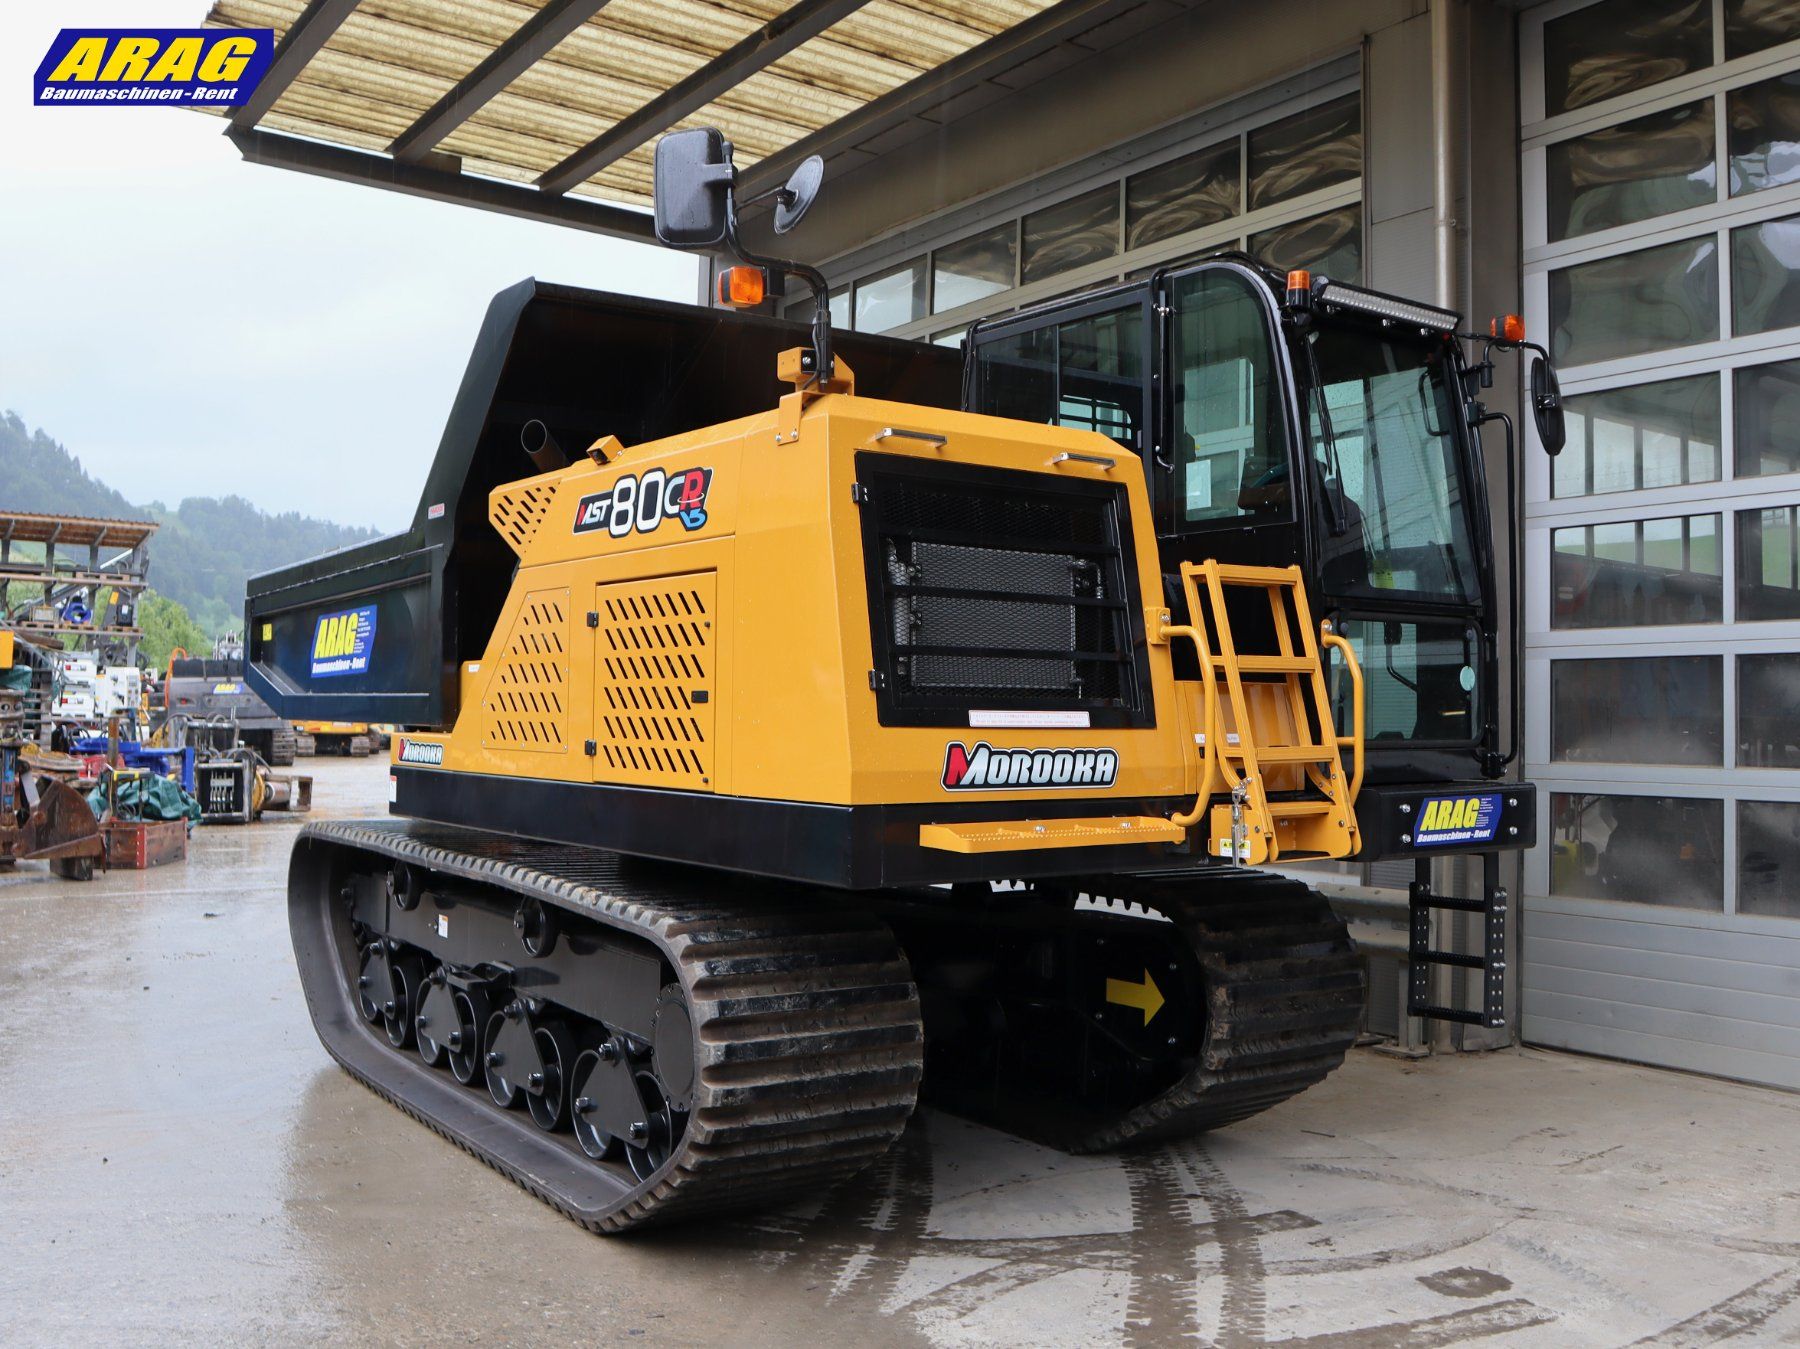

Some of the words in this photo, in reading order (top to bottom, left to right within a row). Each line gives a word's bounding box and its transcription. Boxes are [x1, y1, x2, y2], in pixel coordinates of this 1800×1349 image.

[314, 612, 359, 659] ARAG
[399, 738, 443, 765] MOROOKA
[946, 746, 1115, 785] MOROOKA
[1420, 798, 1480, 831] ARAG
